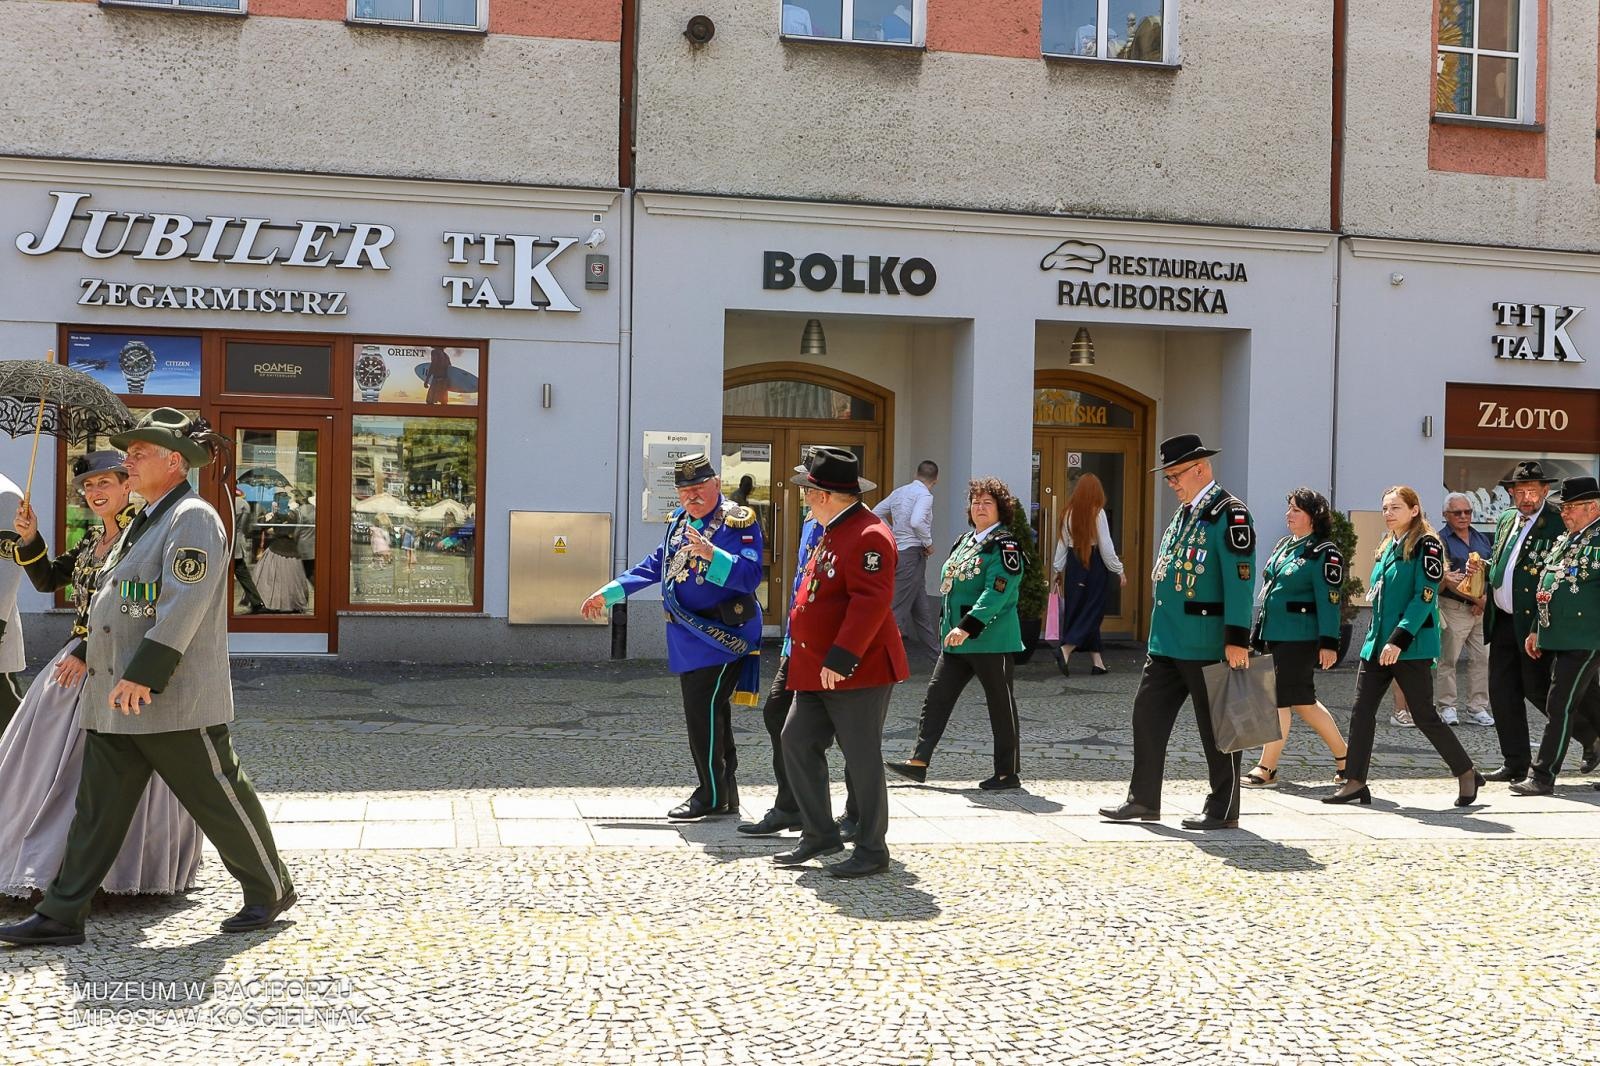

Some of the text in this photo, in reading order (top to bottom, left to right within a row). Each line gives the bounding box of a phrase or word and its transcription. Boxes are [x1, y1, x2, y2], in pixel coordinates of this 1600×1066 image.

[15, 191, 396, 270] JUBILER
[763, 250, 937, 296] BOLKO
[1108, 255, 1248, 282] RESTAURACJA
[78, 277, 348, 315] ZEGARMISTRZ
[1058, 280, 1229, 314] RACIBORSKA
[254, 362, 302, 375] ROAMER
[387, 348, 426, 357] ORIENT
[1477, 401, 1569, 431] ZŁOTO
